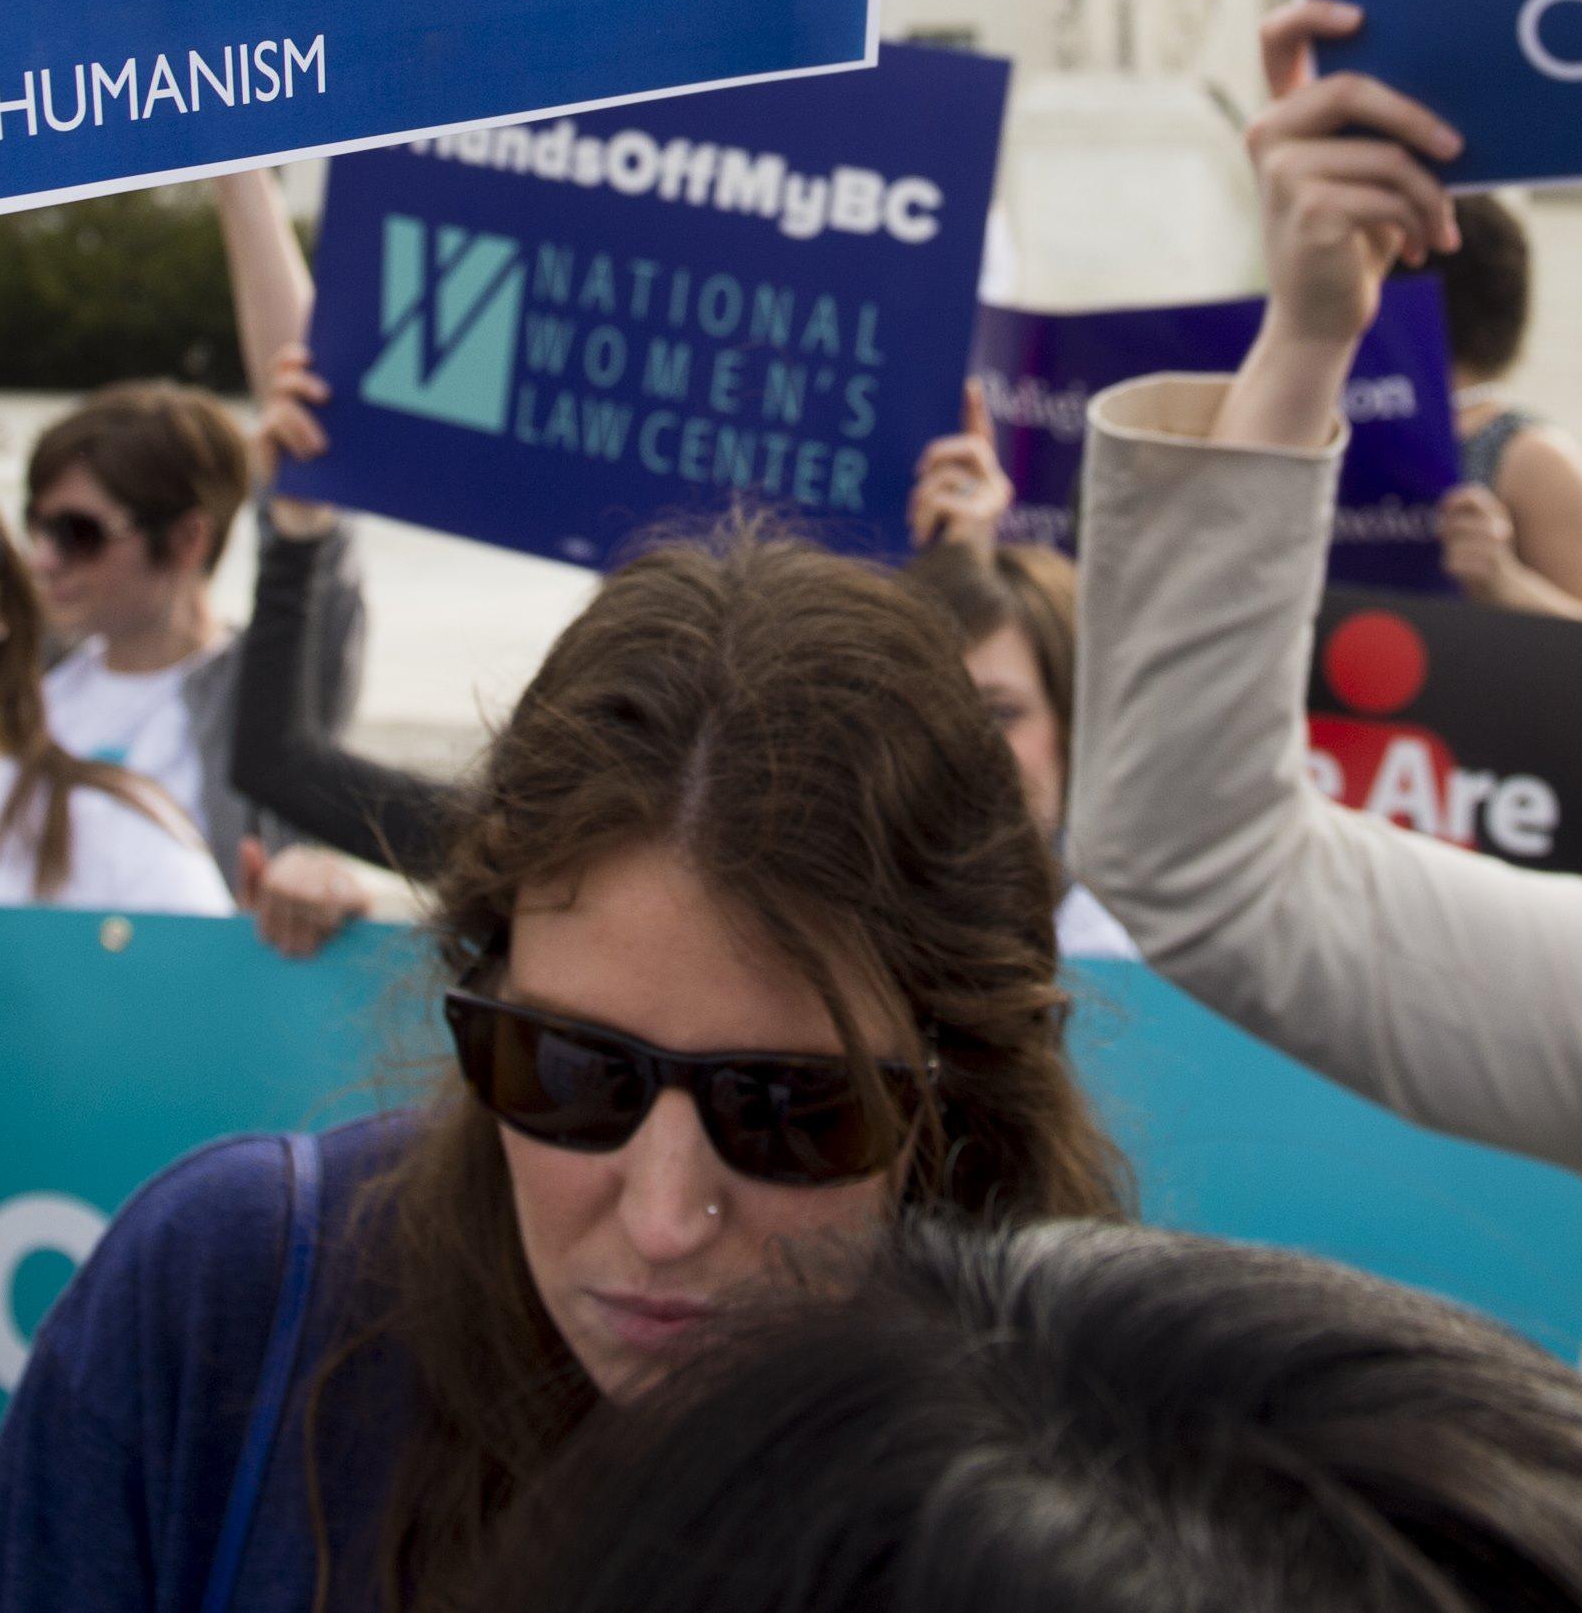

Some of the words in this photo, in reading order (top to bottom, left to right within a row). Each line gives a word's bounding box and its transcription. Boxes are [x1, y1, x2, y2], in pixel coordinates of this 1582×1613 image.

[397, 118, 944, 245] andsOffMyBC
[532, 240, 885, 367] NATIONAL
[523, 311, 879, 441] WOMEN'S
[515, 382, 634, 463] LAW
[637, 409, 870, 513] CENTER
[1365, 732, 1562, 859] Are
